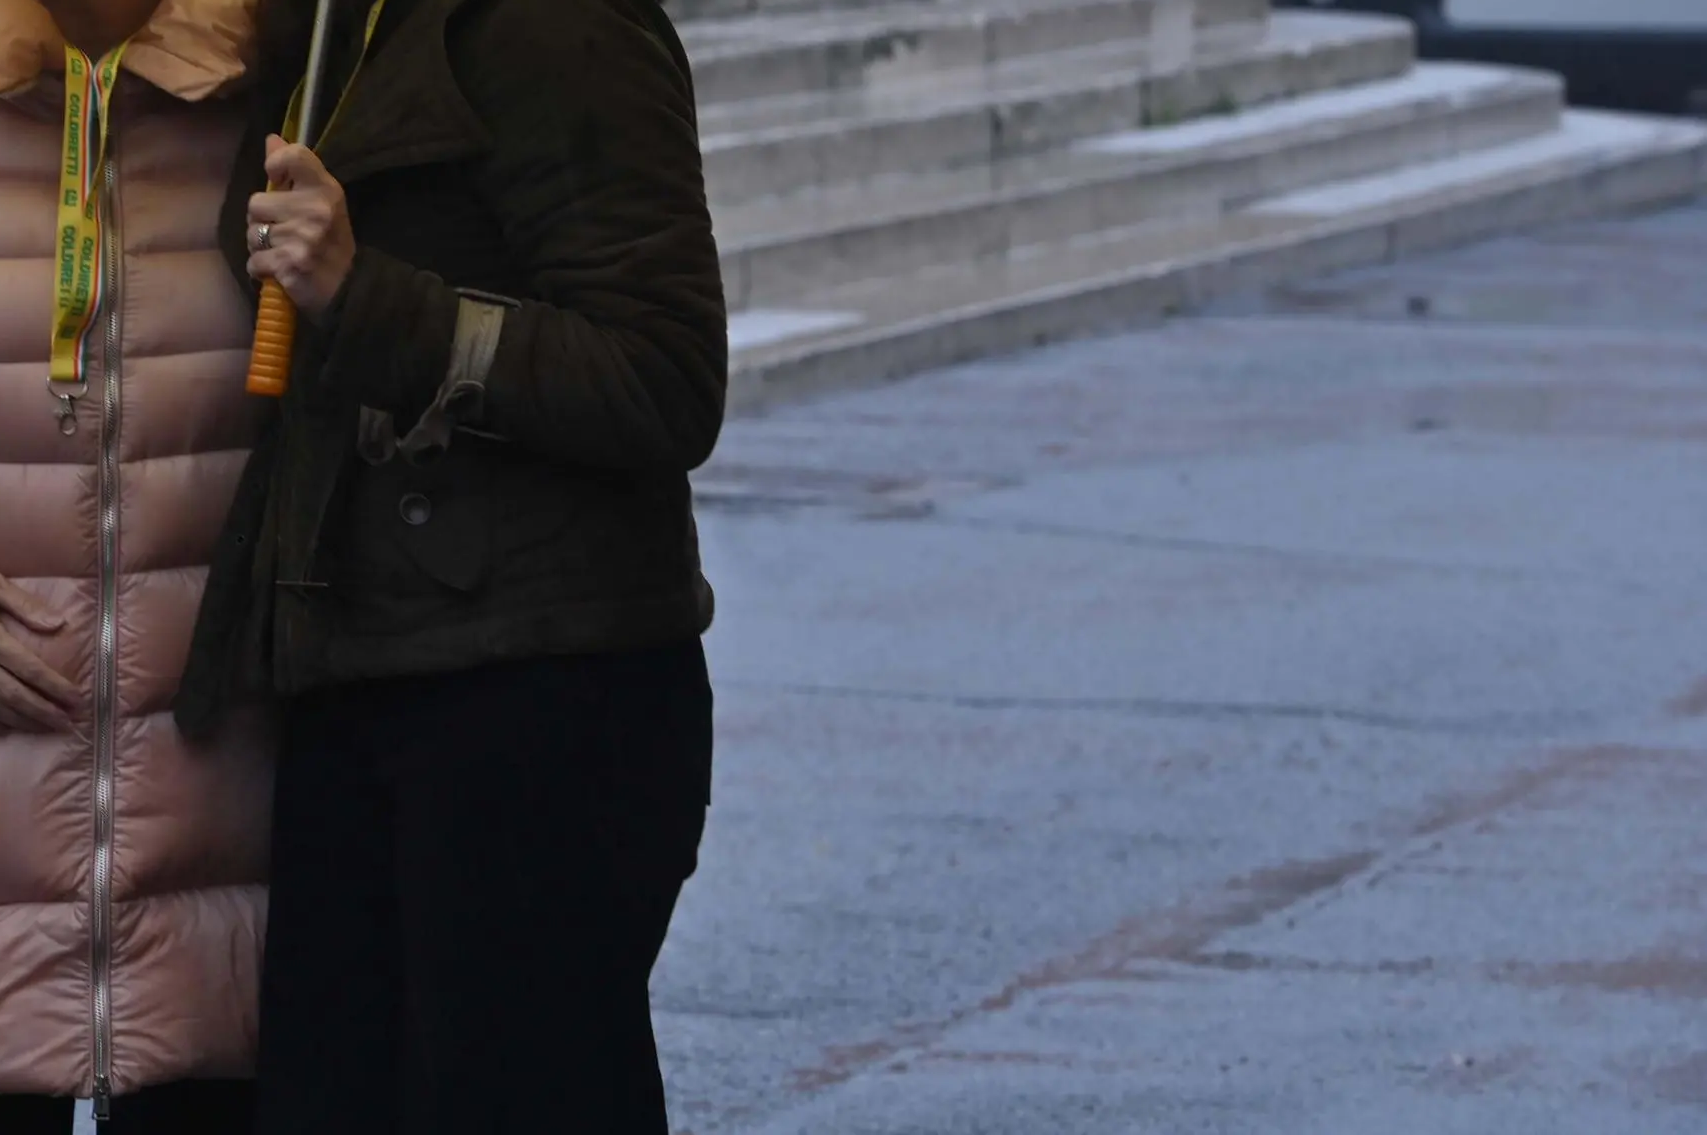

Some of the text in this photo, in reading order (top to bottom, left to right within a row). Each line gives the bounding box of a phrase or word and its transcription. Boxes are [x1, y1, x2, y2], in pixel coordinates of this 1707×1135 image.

[65, 93, 81, 176] COLDIRETTI
[59, 225, 76, 308] COLDIRETTI
[71, 235, 94, 316] COLDIRETTI
